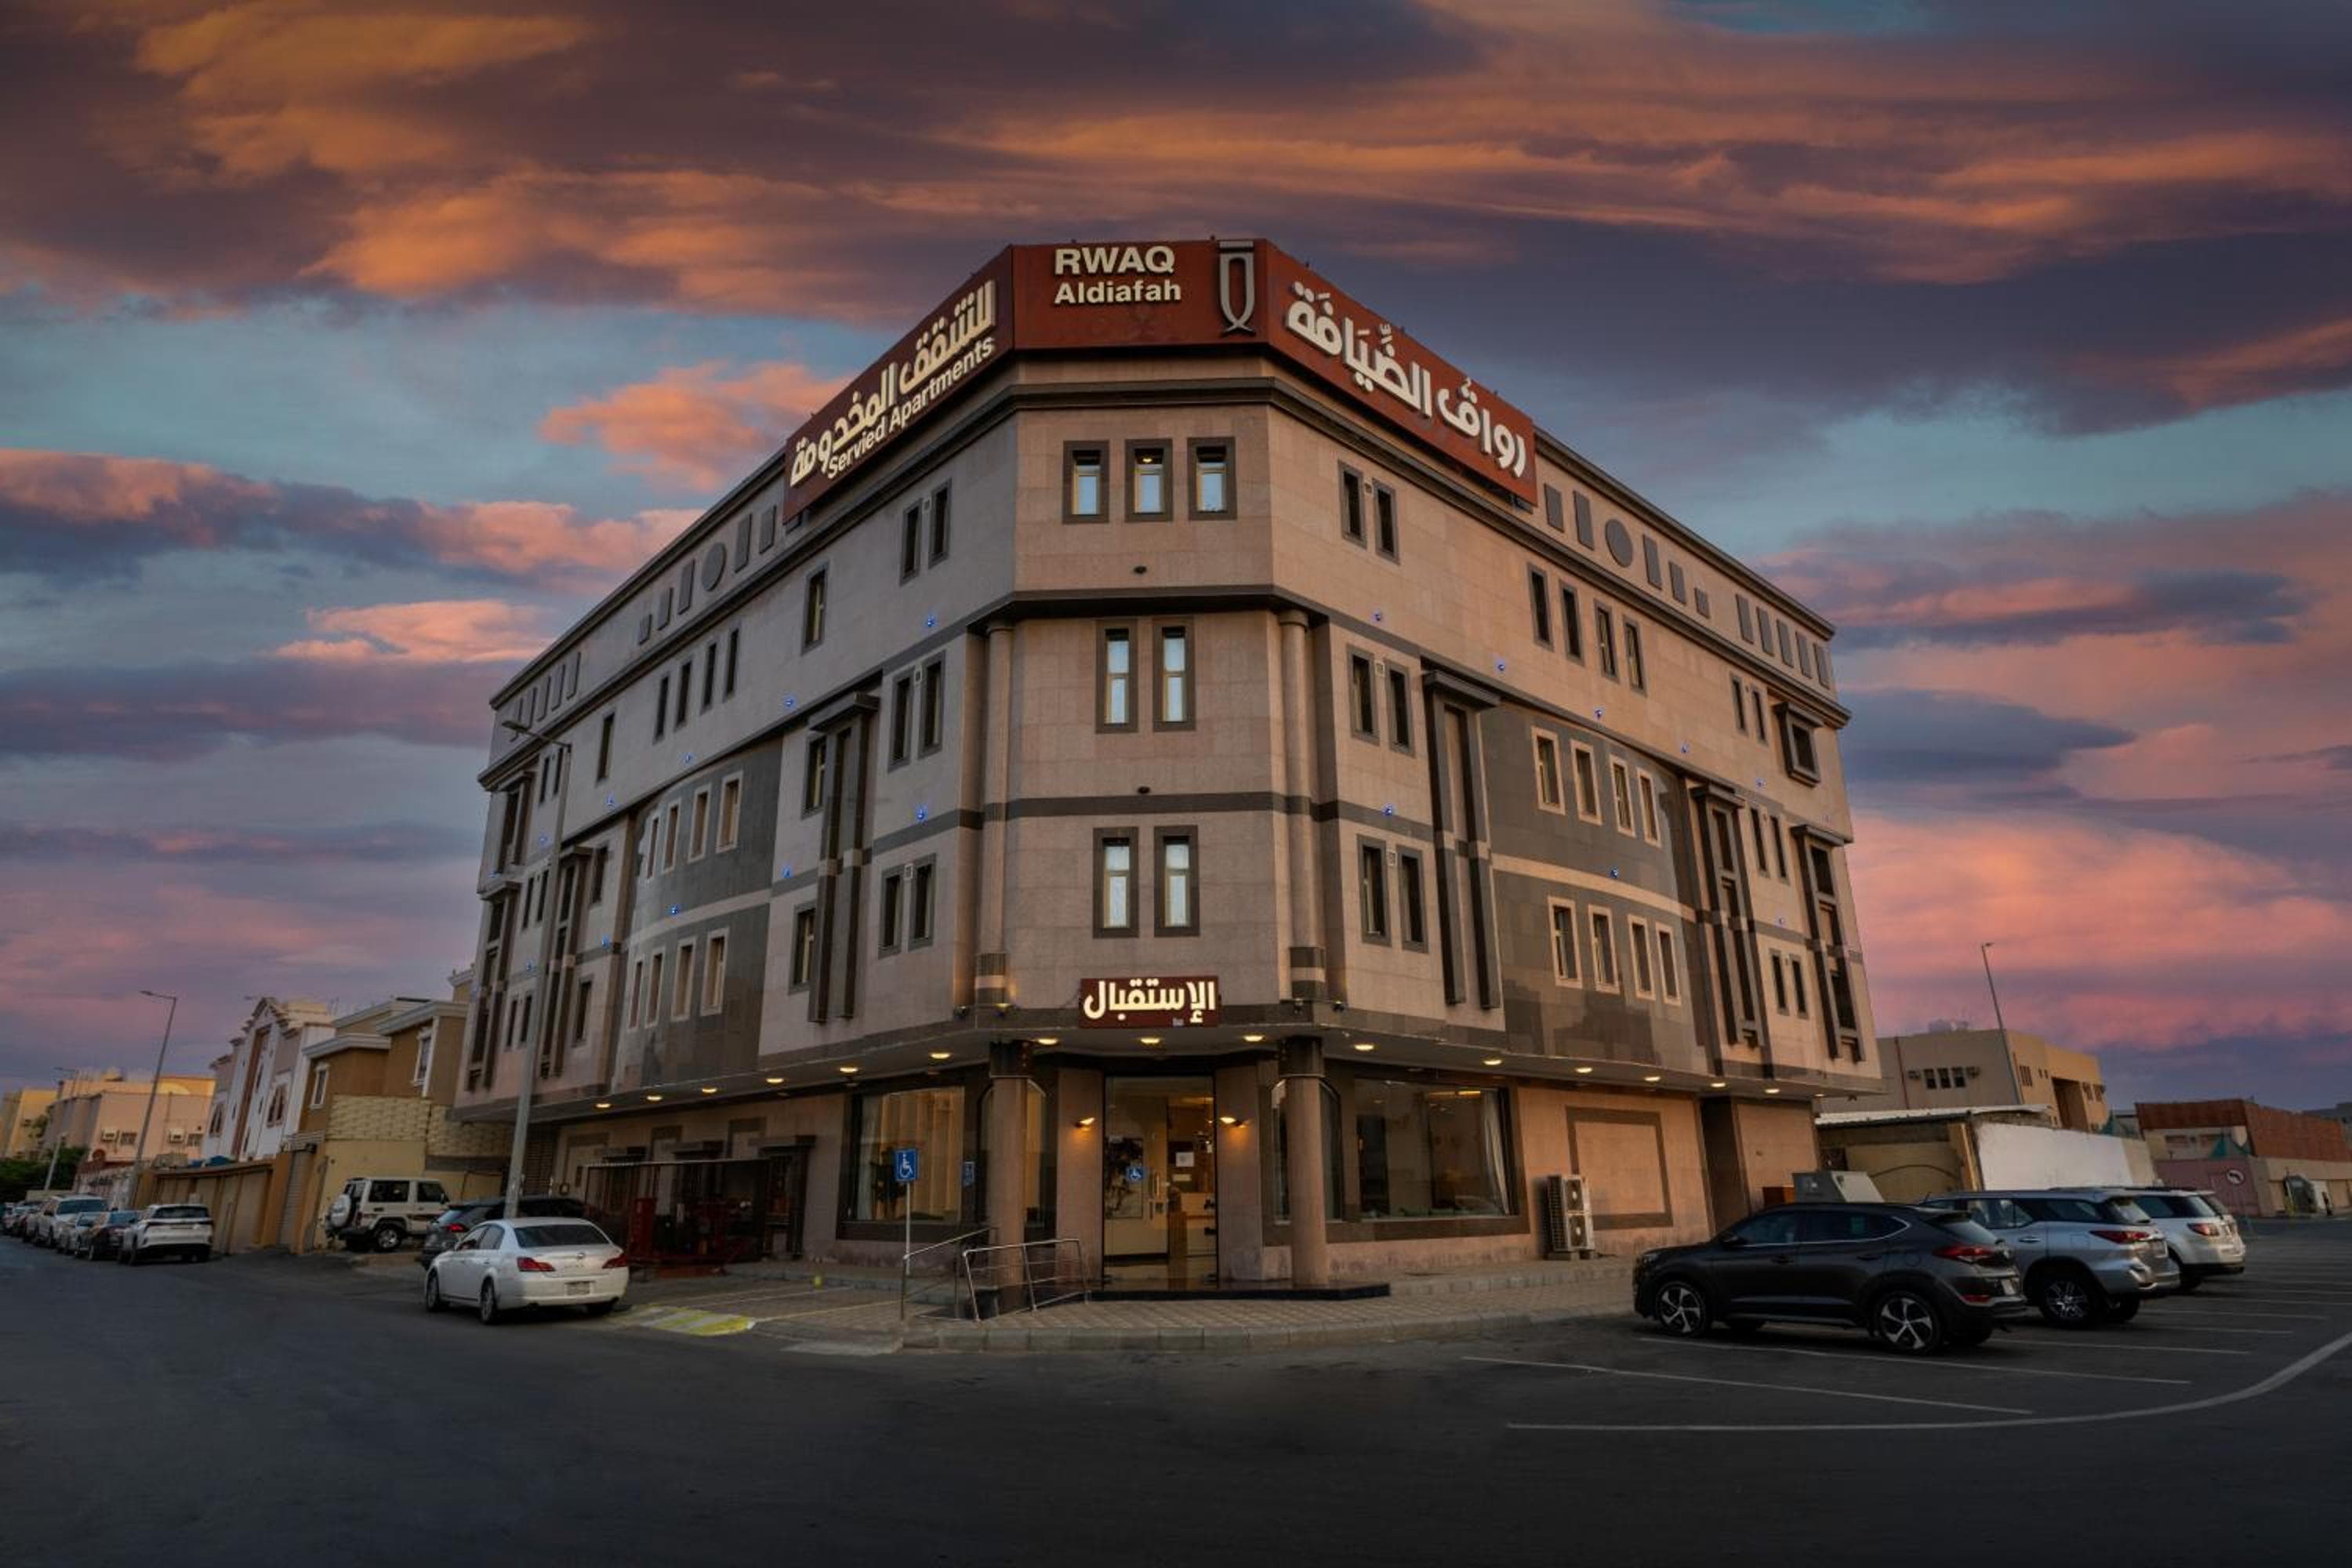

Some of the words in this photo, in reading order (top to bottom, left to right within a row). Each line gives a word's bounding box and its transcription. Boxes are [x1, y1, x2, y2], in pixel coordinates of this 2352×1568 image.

[1054, 245, 1175, 275] RWAQ
[1054, 279, 1181, 304] Aldiafah
[789, 362, 898, 488] المخدومة
[828, 416, 887, 479] Servied
[889, 336, 995, 432] Apartments
[1083, 978, 1216, 1024] الإستقبال
